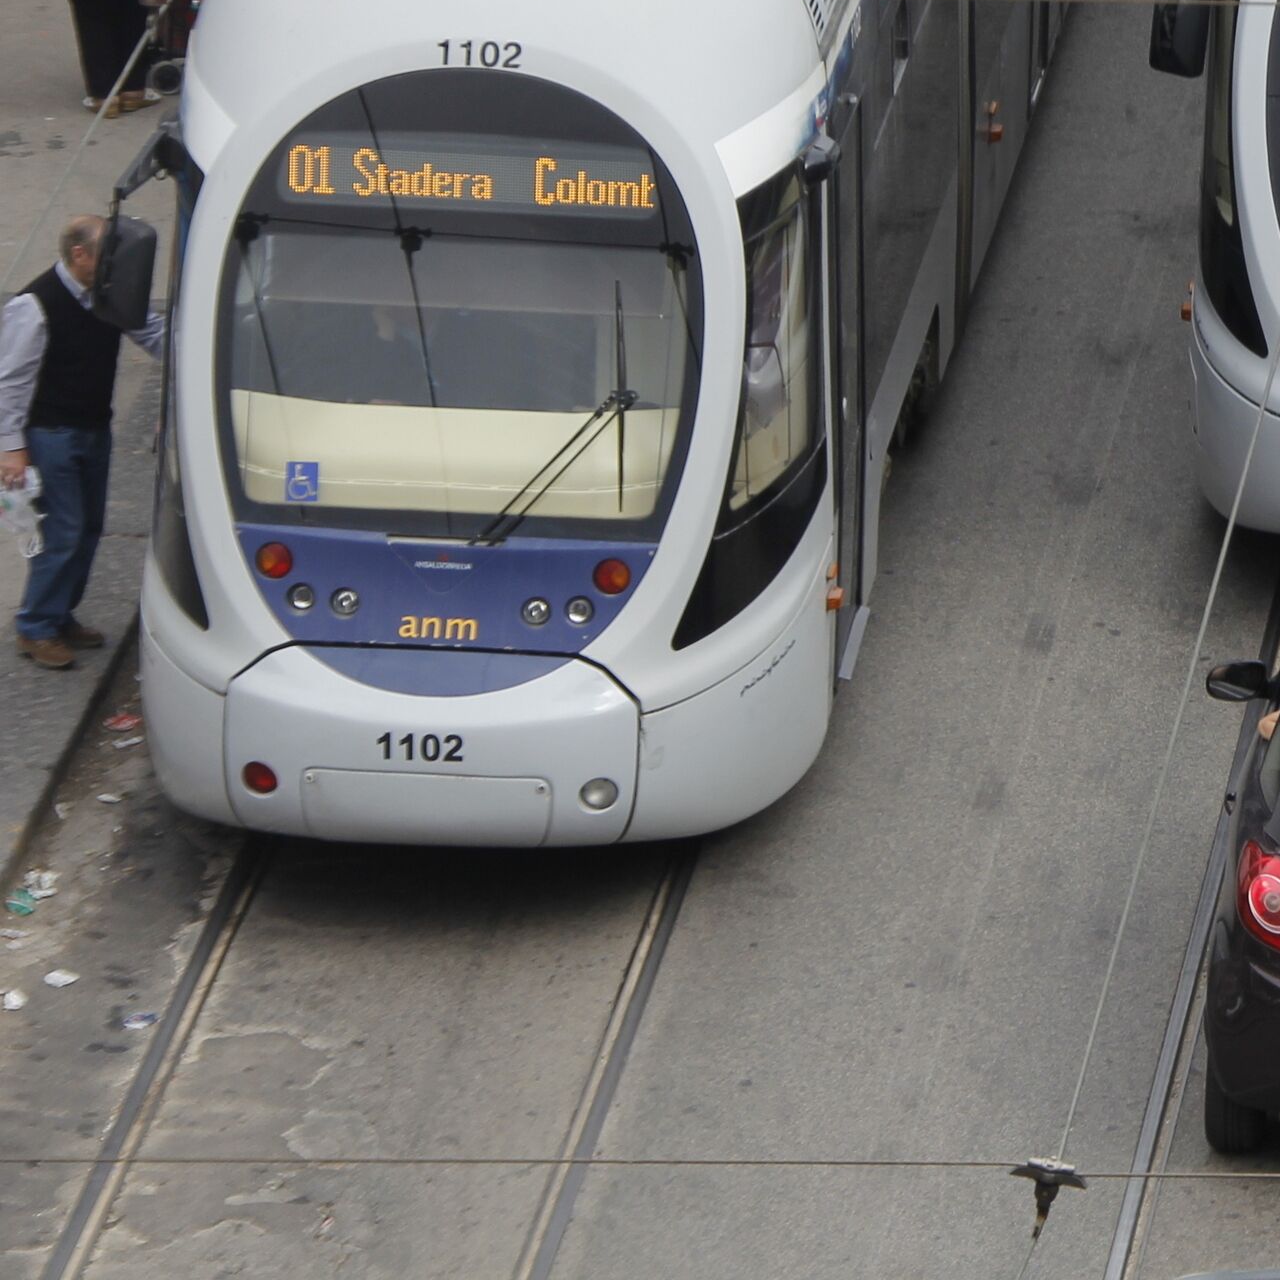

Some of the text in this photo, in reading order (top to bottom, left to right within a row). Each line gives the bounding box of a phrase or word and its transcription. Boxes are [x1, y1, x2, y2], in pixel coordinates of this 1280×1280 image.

[437, 38, 523, 69] 1102
[289, 144, 336, 195] 01
[353, 147, 494, 201] Stadera
[398, 614, 479, 641] anm
[375, 731, 464, 762] 1102
